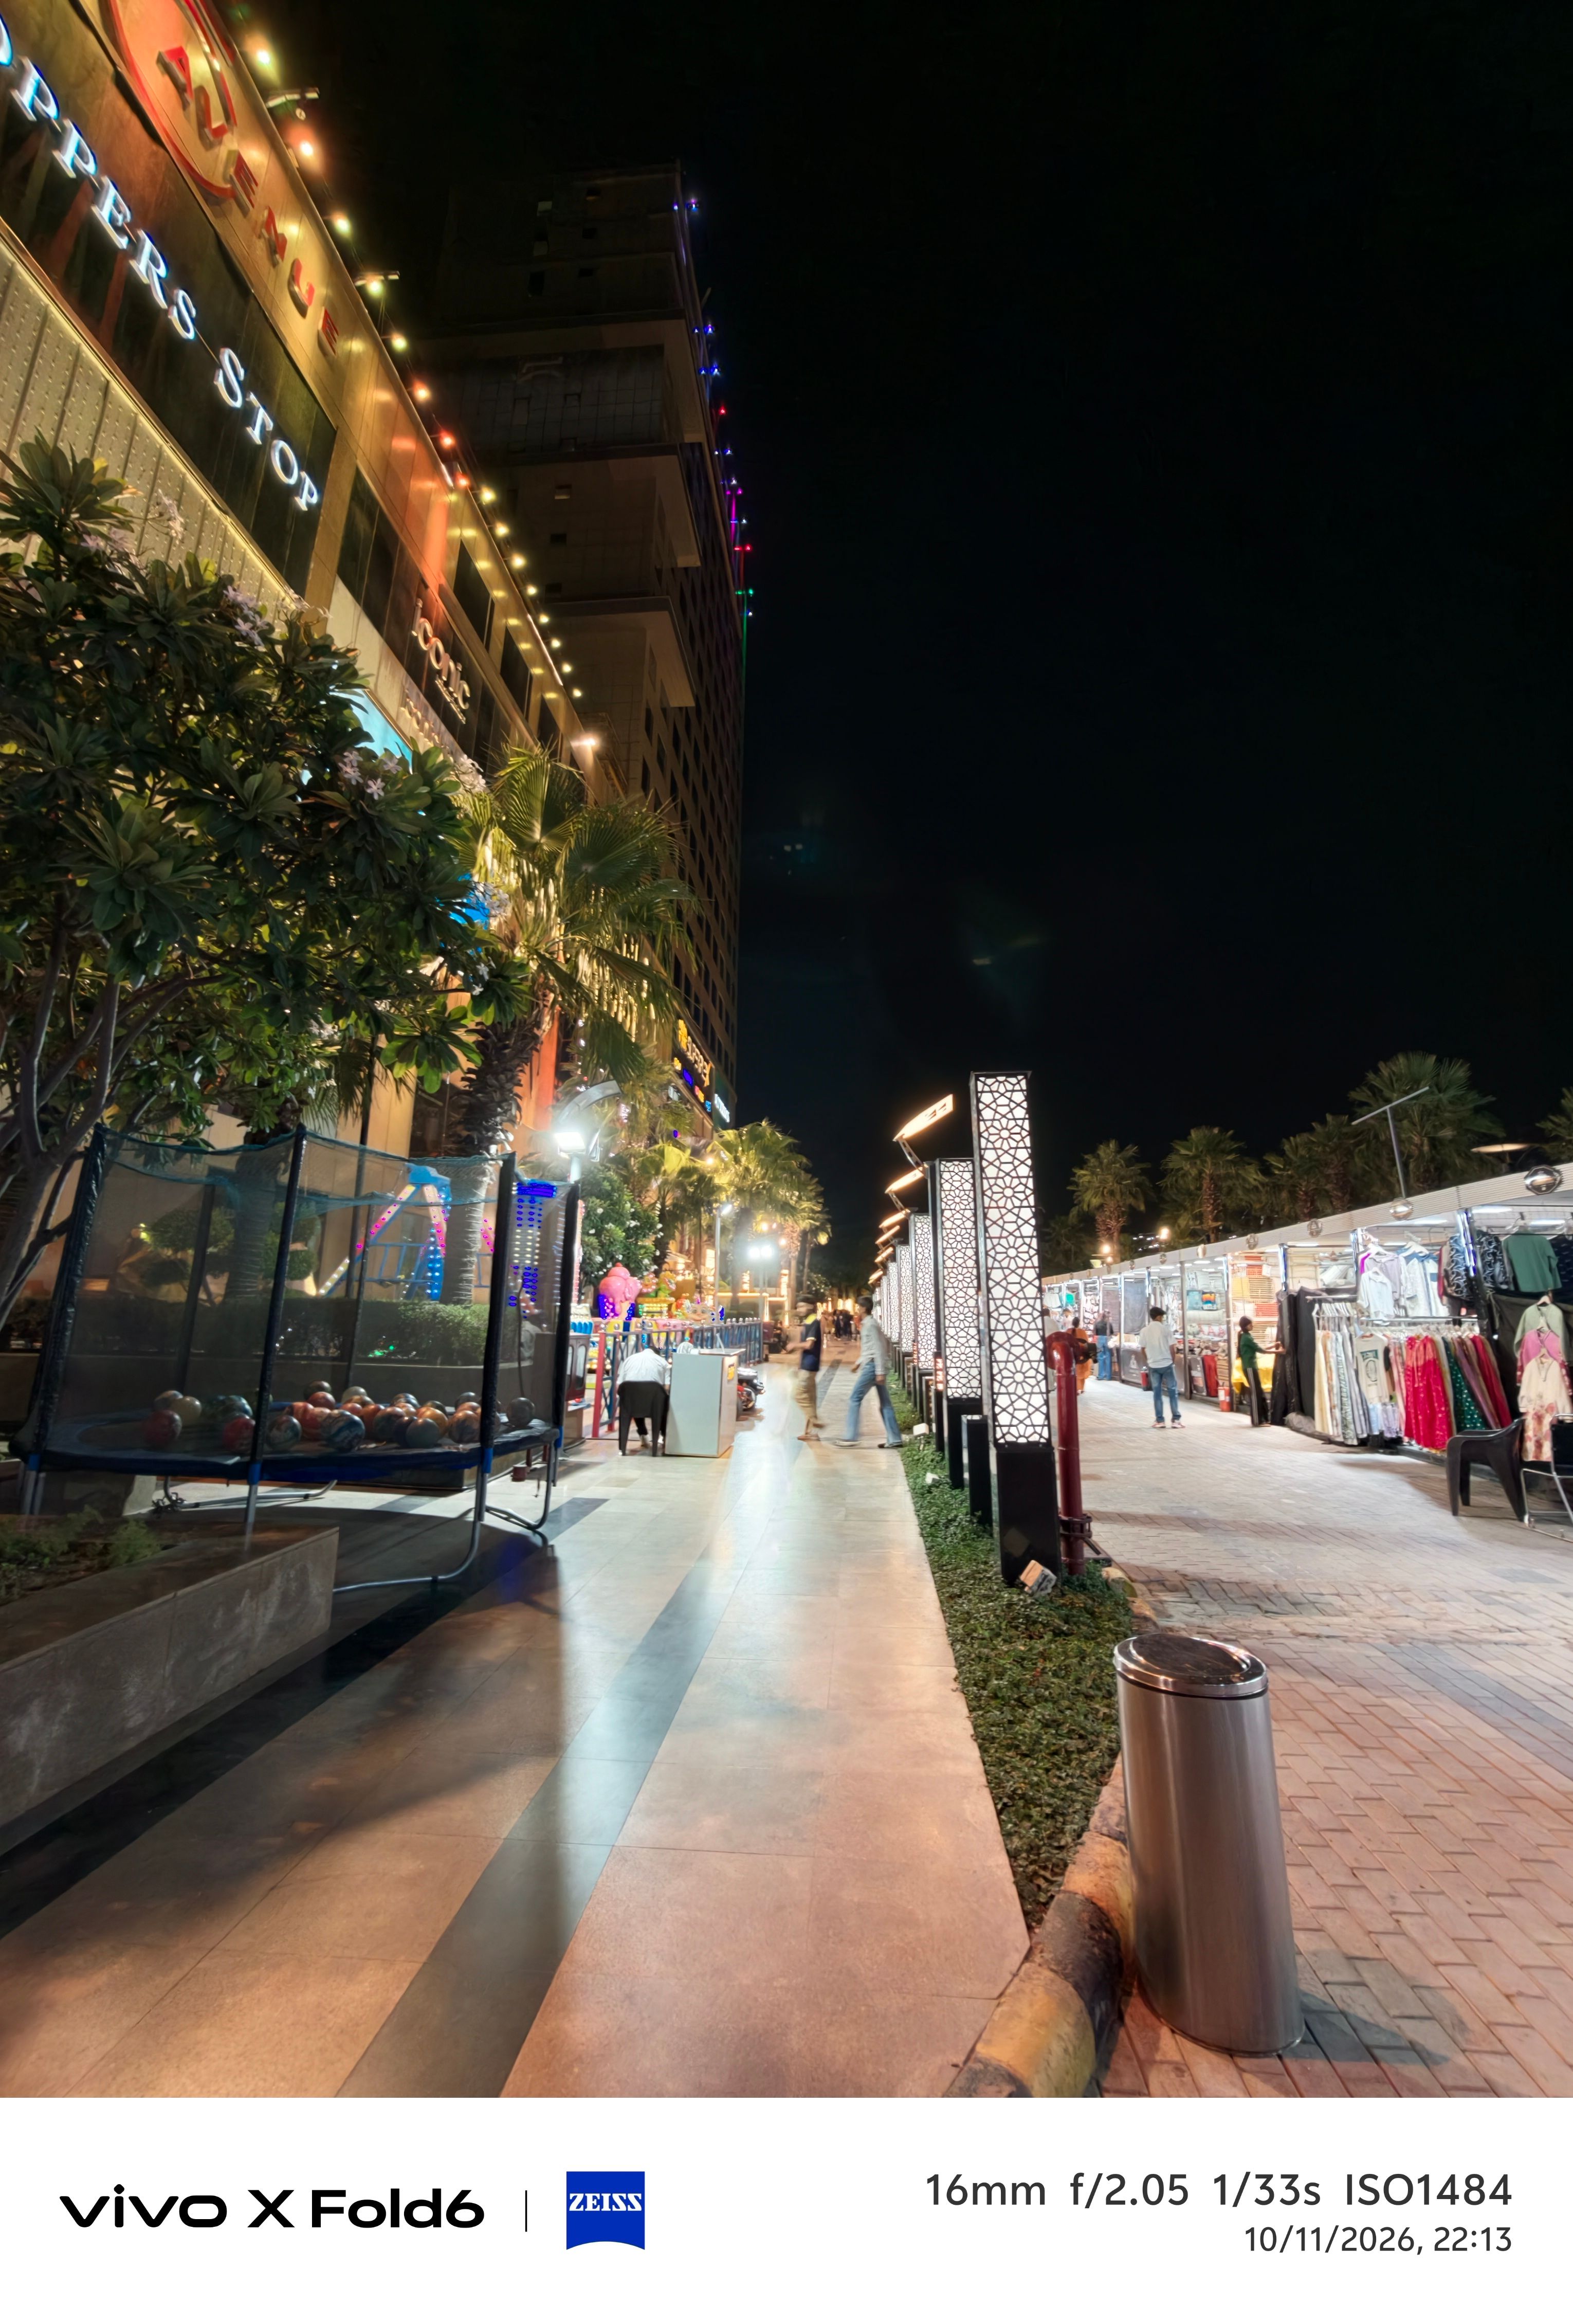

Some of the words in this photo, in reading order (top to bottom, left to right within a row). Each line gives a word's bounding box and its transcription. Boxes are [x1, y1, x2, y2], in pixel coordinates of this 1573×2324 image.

[0, 13, 196, 340] PPERS
[214, 348, 318, 511] STOP
[156, 46, 340, 355] AVENUE
[411, 597, 471, 710] iconic
